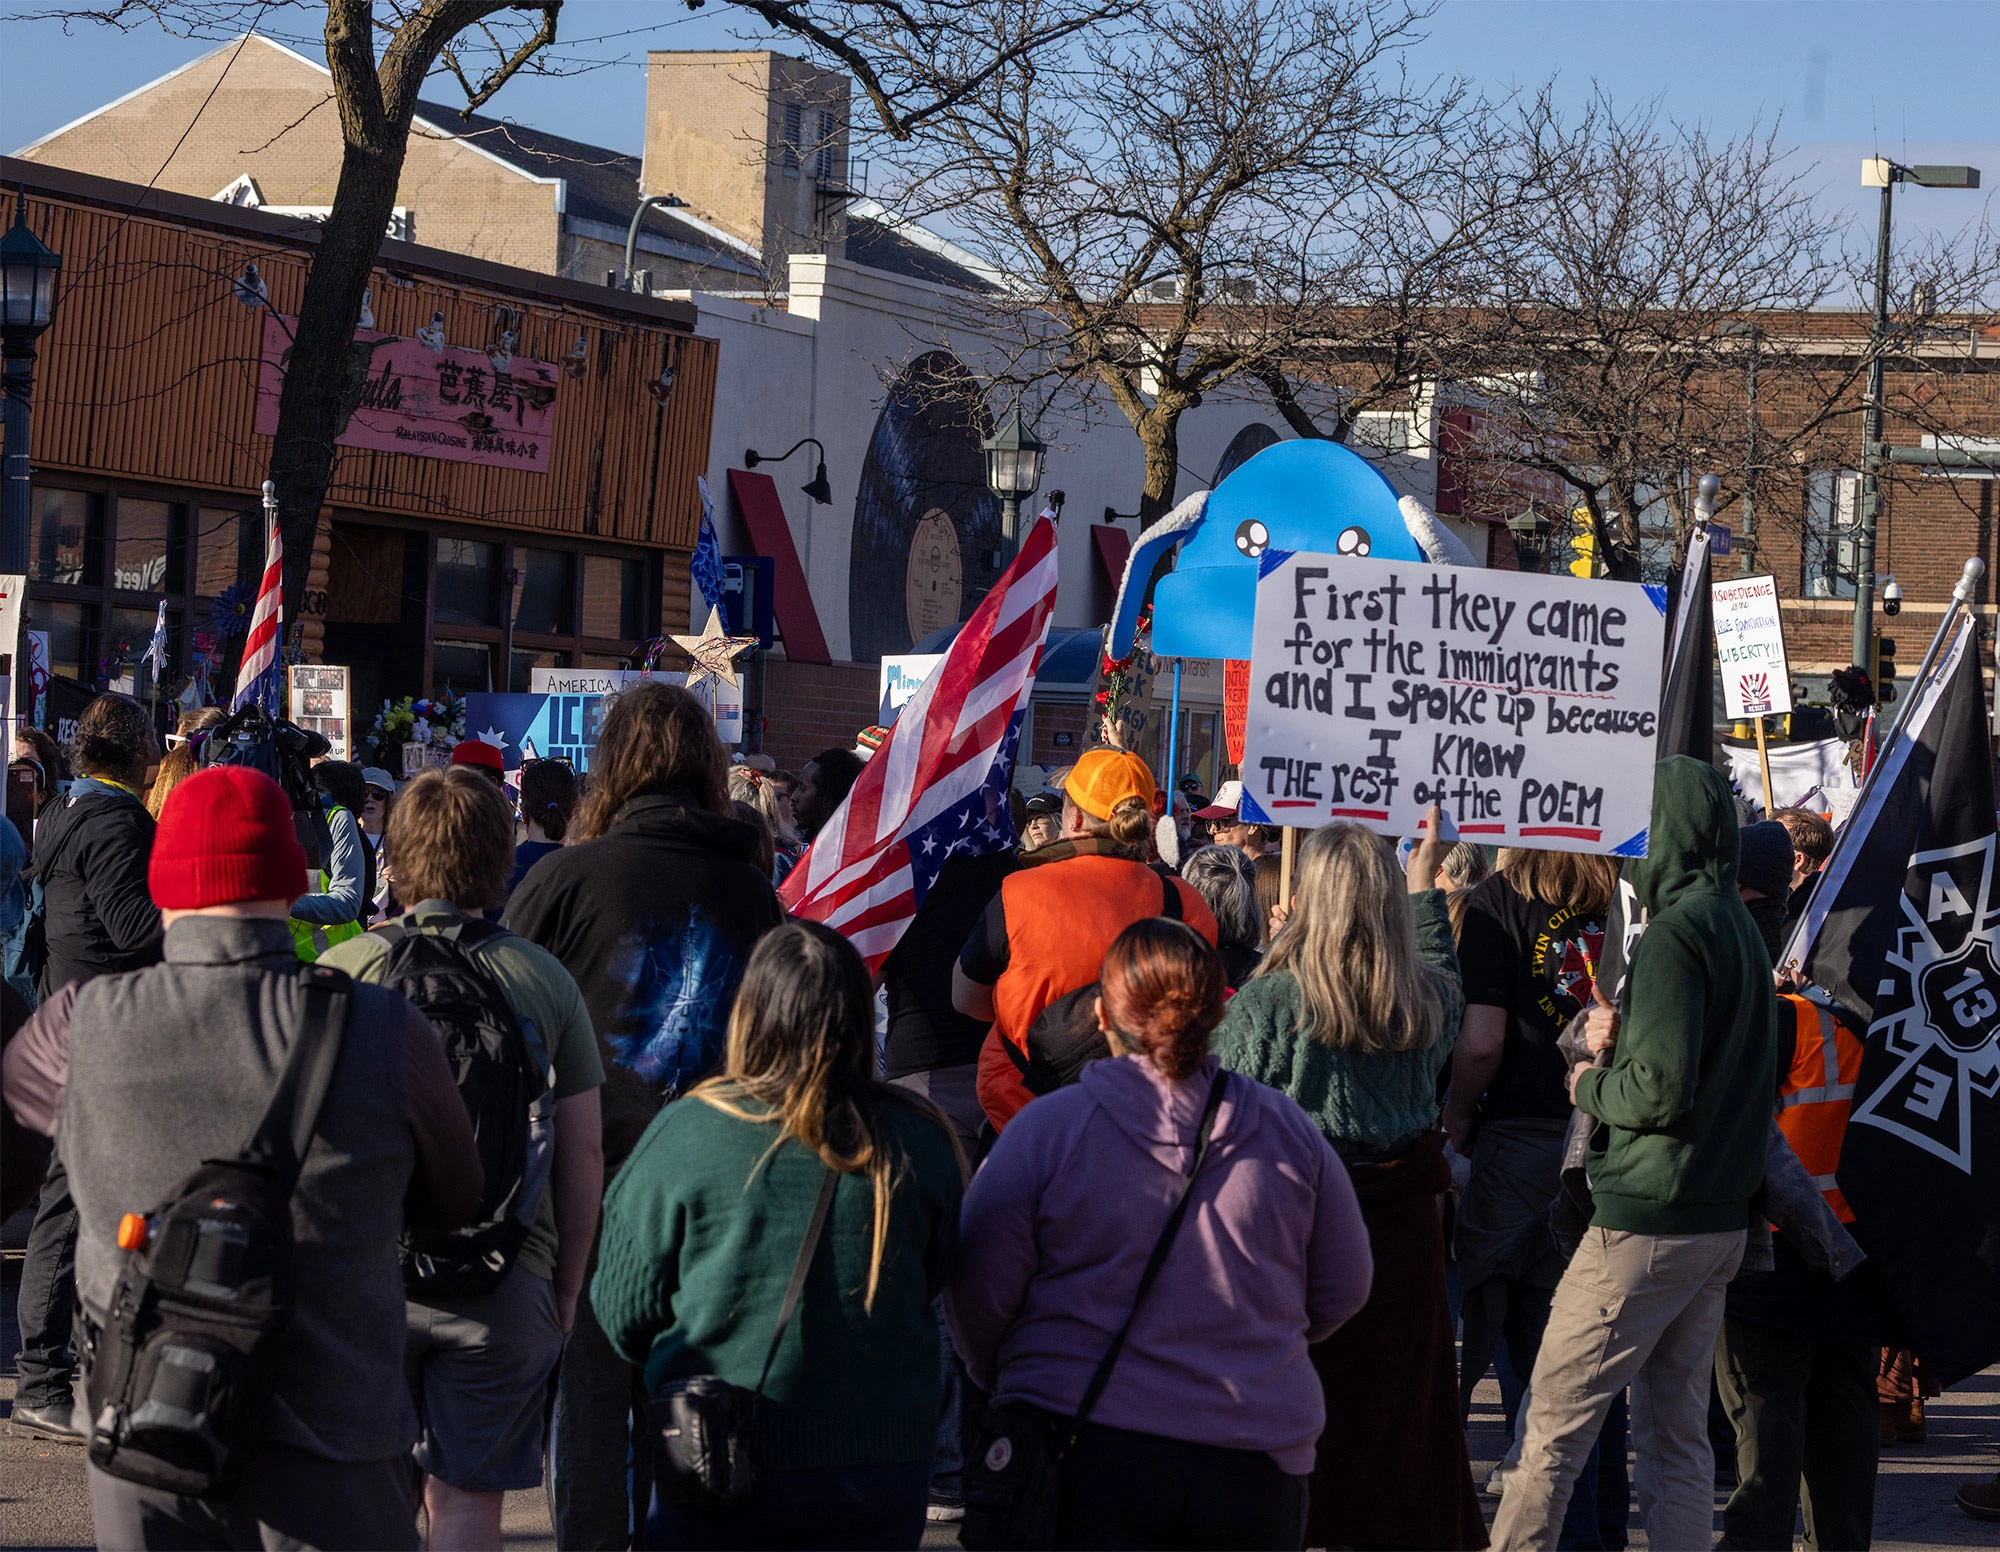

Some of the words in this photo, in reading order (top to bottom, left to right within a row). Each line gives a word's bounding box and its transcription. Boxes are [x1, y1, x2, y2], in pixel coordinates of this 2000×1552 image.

[1293, 566, 1406, 626] First
[1422, 573, 1517, 645] they
[1527, 599, 1627, 648] came
[1711, 583, 1773, 603] ISOBEDIENCE
[1162, 657, 1187, 675] Meo
[1284, 621, 1353, 669] for
[1363, 628, 1425, 676] the
[1437, 640, 1620, 696] immigrants
[1719, 642, 1780, 663] LIBERTY!!
[547, 675, 617, 693] AMERICA,
[1265, 668, 1334, 716] and
[1344, 673, 1376, 720] I
[1495, 693, 1536, 737] up
[1546, 696, 1656, 738] because
[548, 696, 603, 745] ICE
[1748, 704, 1766, 713] RESIST
[1366, 728, 1402, 769] I
[1259, 756, 1323, 800] THE
[1330, 762, 1399, 807] rest
[1413, 778, 1447, 821] of
[1450, 777, 1502, 822] the
[1518, 778, 1604, 826] POEM
[1531, 931, 1551, 978] TWIN
[1547, 903, 1588, 930] CITIE
[1537, 994, 1557, 1017] 130
[1942, 966, 1998, 1029] 13
